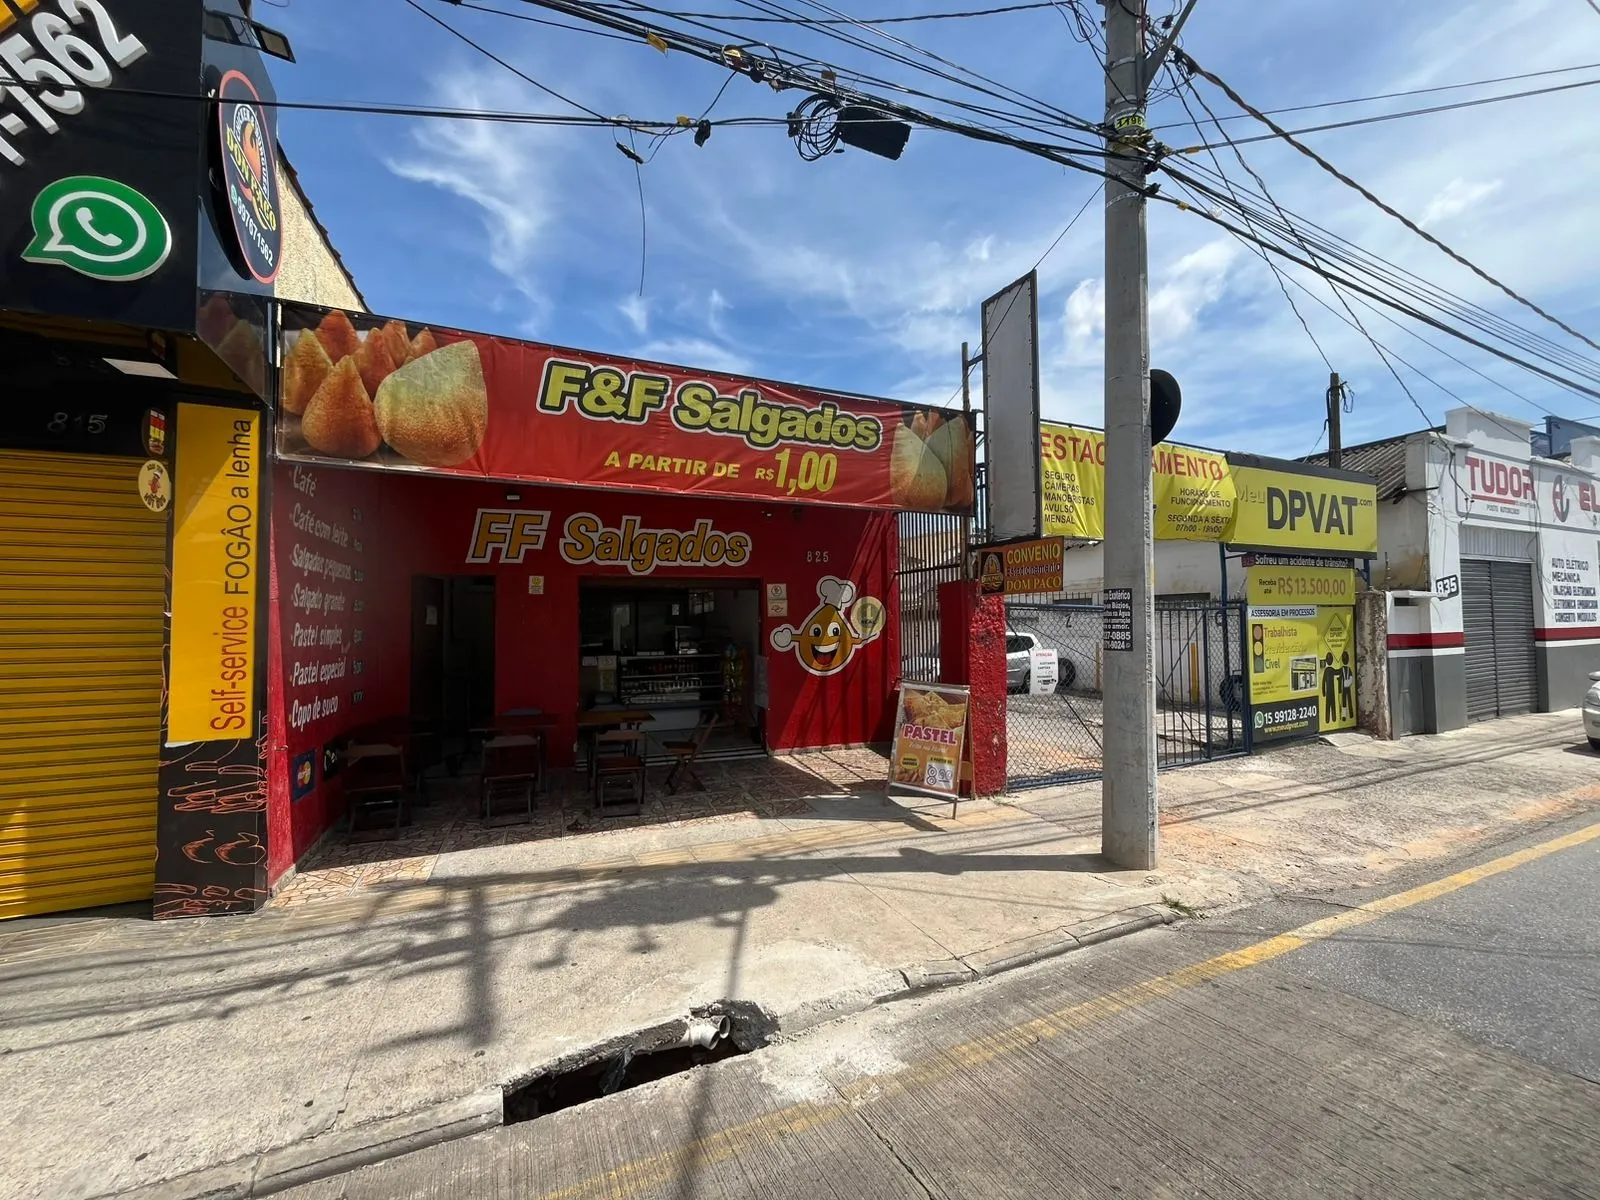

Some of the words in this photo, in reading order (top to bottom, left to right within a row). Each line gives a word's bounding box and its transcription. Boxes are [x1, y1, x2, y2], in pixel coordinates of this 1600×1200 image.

[539, 359, 670, 424] F&F
[673, 382, 883, 451] Salgados
[224, 420, 251, 478] lenha
[604, 450, 622, 469] A
[627, 453, 708, 477] PARTIR
[713, 461, 741, 480] DE
[293, 464, 316, 498] Café
[1045, 470, 1076, 482] SEGURO
[1465, 456, 1536, 501] TUDOR
[231, 486, 249, 499] a
[1044, 493, 1095, 505] MANOBRISTAS
[292, 502, 315, 533] Café
[1044, 504, 1075, 513] AVULSO
[1044, 514, 1076, 525] MENSAL
[466, 509, 551, 564] FF
[560, 515, 752, 575] Salgados
[806, 551, 830, 563] 825
[1255, 554, 1277, 565] Sofreu
[1289, 557, 1315, 566] acidente
[1316, 558, 1324, 567] de
[1006, 579, 1031, 591] DOM
[1034, 576, 1062, 589] PACO
[1258, 578, 1277, 586] Receba
[1437, 576, 1458, 595] 835
[293, 621, 318, 648] Pastel
[1264, 624, 1298, 639] Trabalhista
[209, 606, 248, 730] Self-service
[292, 661, 319, 688] Pastel
[320, 657, 347, 685] especial
[291, 699, 311, 732] Copo
[312, 695, 321, 720] de
[1264, 712, 1273, 725] 15
[1274, 705, 1317, 723] 99128-2240
[903, 724, 957, 746] PASTEL
